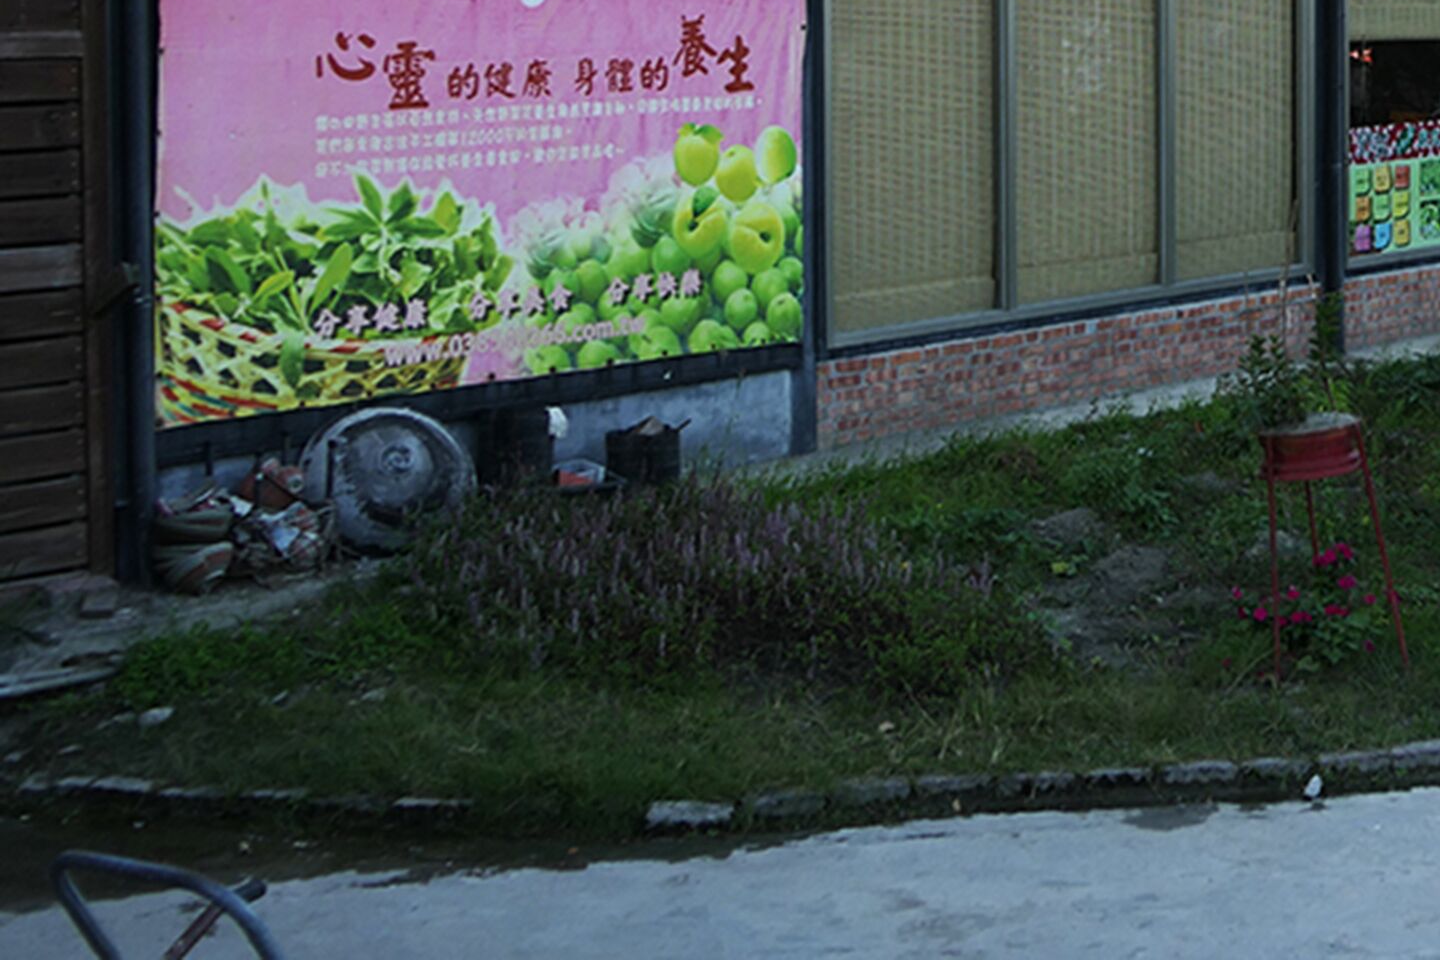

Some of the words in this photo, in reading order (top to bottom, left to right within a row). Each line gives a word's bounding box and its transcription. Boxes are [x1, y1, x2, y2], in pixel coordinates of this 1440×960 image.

[315, 31, 553, 110] 心靈的健康
[572, 13, 755, 97] 身體的養生
[313, 297, 428, 339] 分享健康
